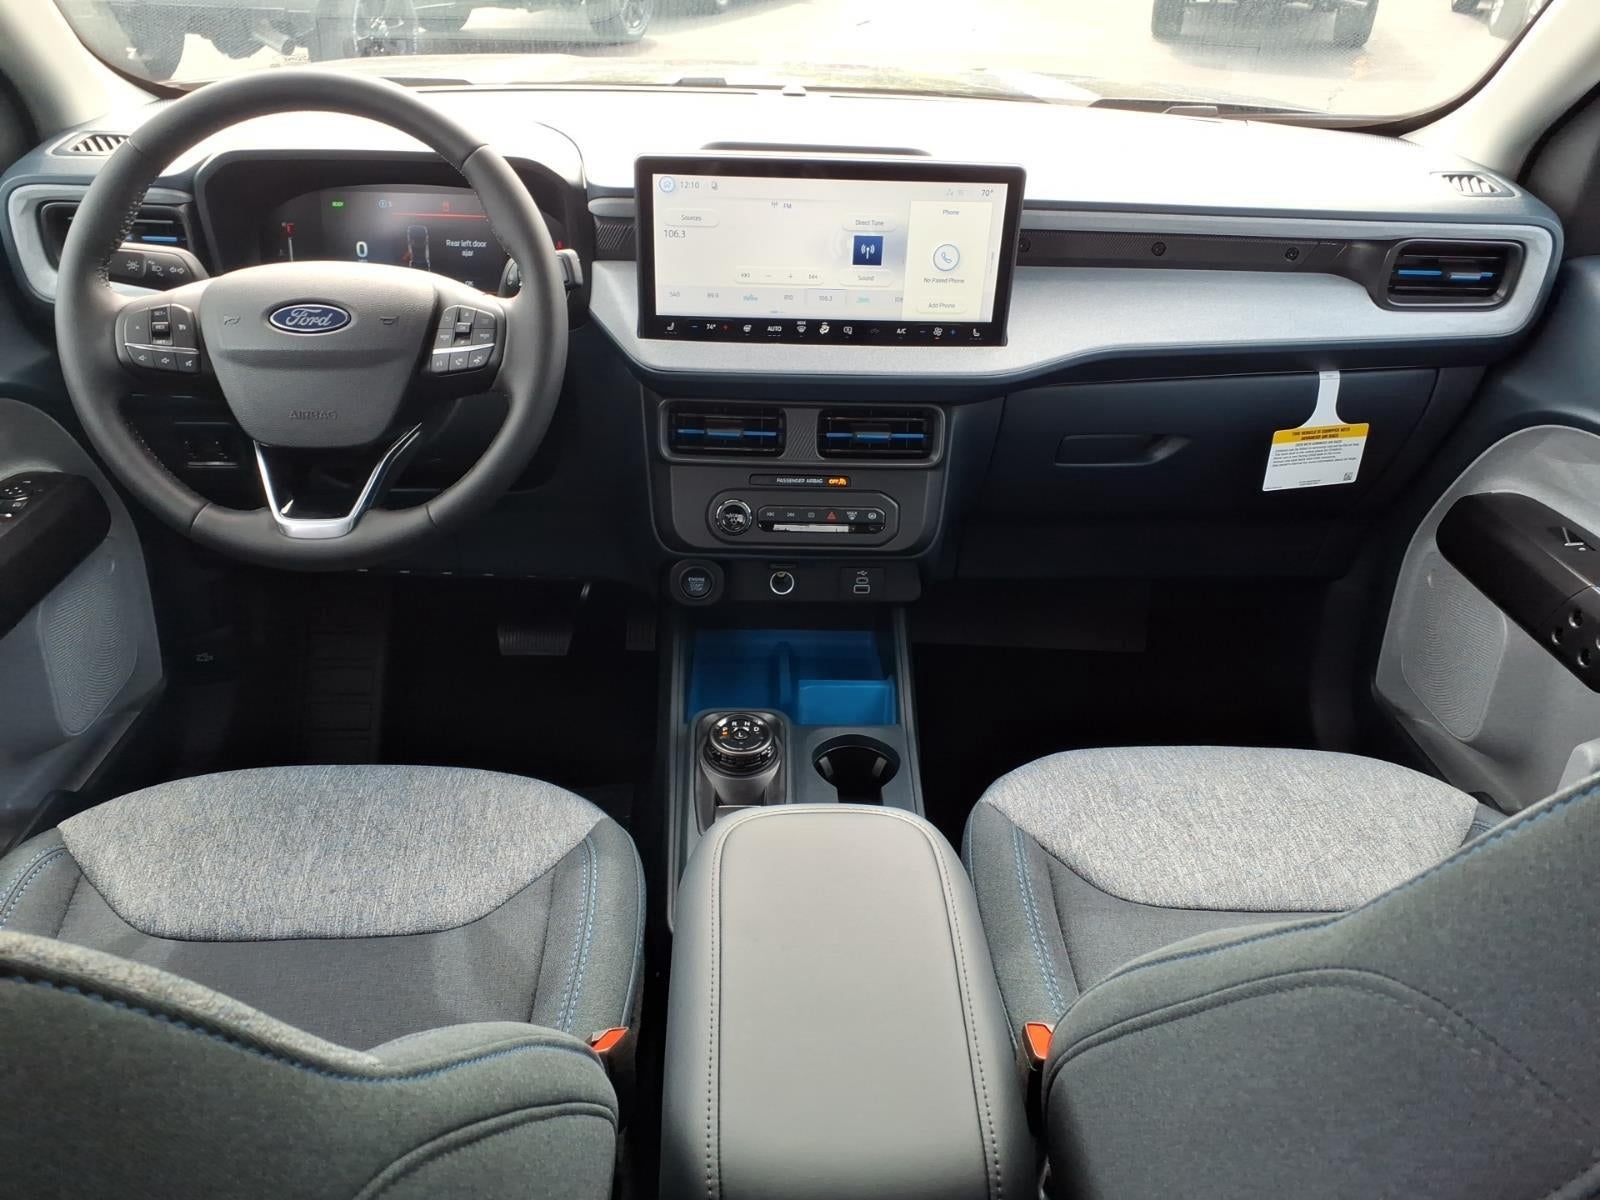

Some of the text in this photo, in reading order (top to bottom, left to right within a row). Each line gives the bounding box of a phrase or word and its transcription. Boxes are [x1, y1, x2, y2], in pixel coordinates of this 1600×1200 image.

[680, 181, 700, 189] 12:10
[681, 214, 702, 222] Sources
[664, 229, 686, 239] 106.3
[446, 239, 488, 248] Rear left door
[356, 240, 368, 258] 0
[285, 307, 334, 327] Ford
[896, 327, 907, 335] A/C
